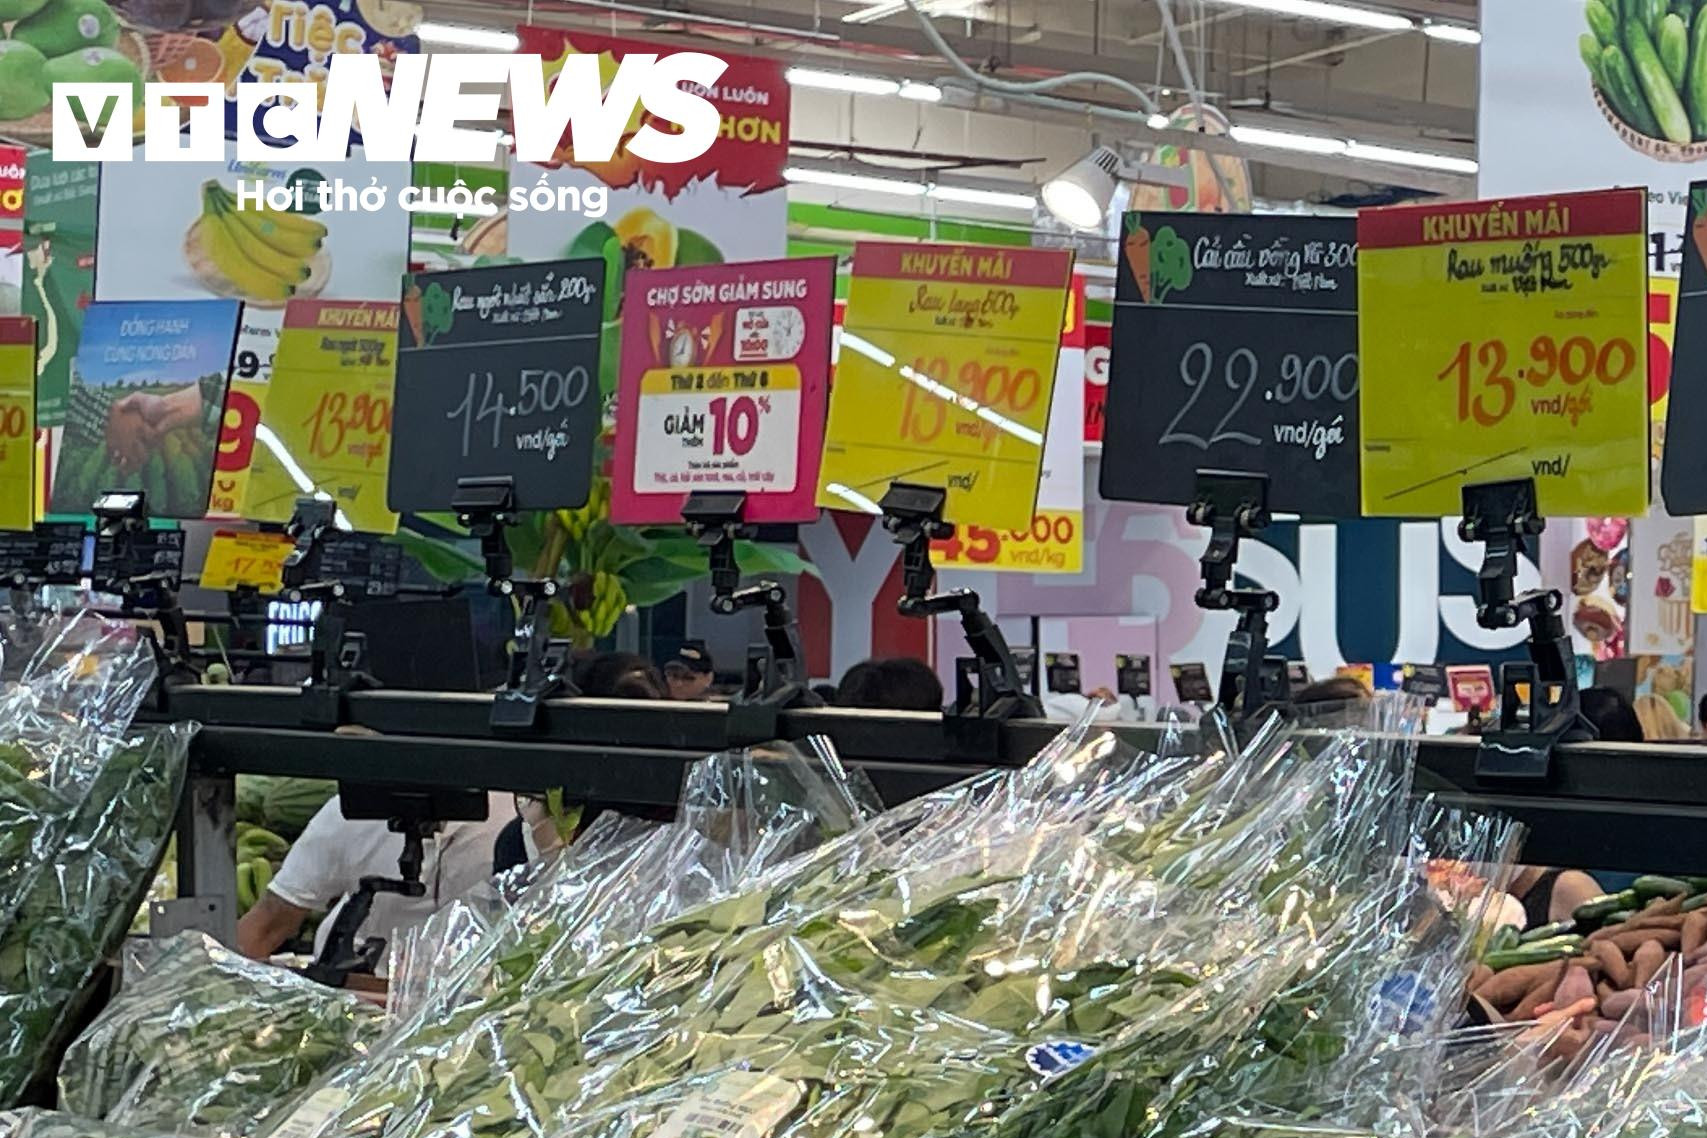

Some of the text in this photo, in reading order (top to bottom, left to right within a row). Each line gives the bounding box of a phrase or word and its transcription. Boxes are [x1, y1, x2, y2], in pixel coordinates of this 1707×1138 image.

[722, 86, 770, 106] LUÔN
[1422, 199, 1519, 242] KHUYẾN
[899, 248, 970, 276] KHUYẾN
[1157, 341, 1360, 451] 22.900
[1438, 334, 1637, 428] 13.900
[446, 366, 590, 458] 14.500
[1531, 454, 1571, 477] vnd/
